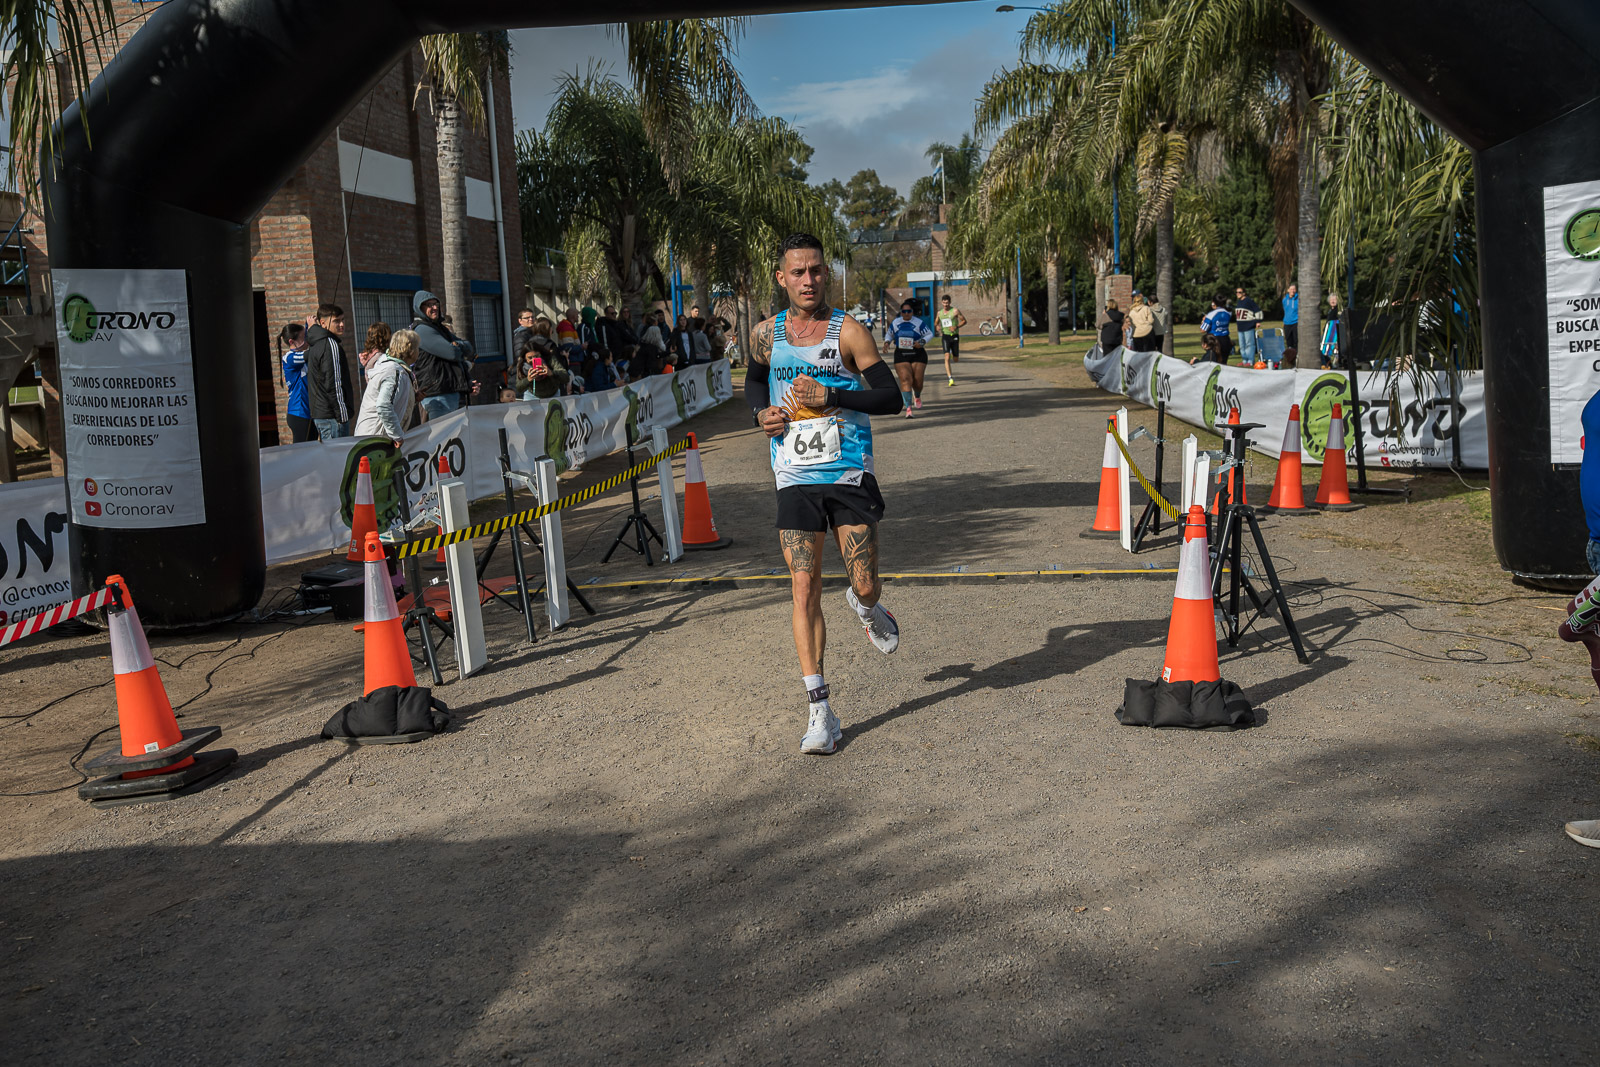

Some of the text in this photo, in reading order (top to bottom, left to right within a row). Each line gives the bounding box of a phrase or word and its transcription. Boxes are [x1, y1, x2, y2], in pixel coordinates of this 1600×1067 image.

[86, 332, 113, 342] RAV
[774, 366, 793, 382] TODO
[806, 365, 840, 378] POSIBLE
[102, 376, 177, 390] CORREDORES
[66, 393, 188, 409] BUSCANDO MEJORAR LAS
[72, 413, 179, 428] EXPERIENCIAS DE LOS
[794, 431, 826, 456] 64
[103, 482, 174, 496] Cronorav
[105, 502, 175, 516] Cronorav
